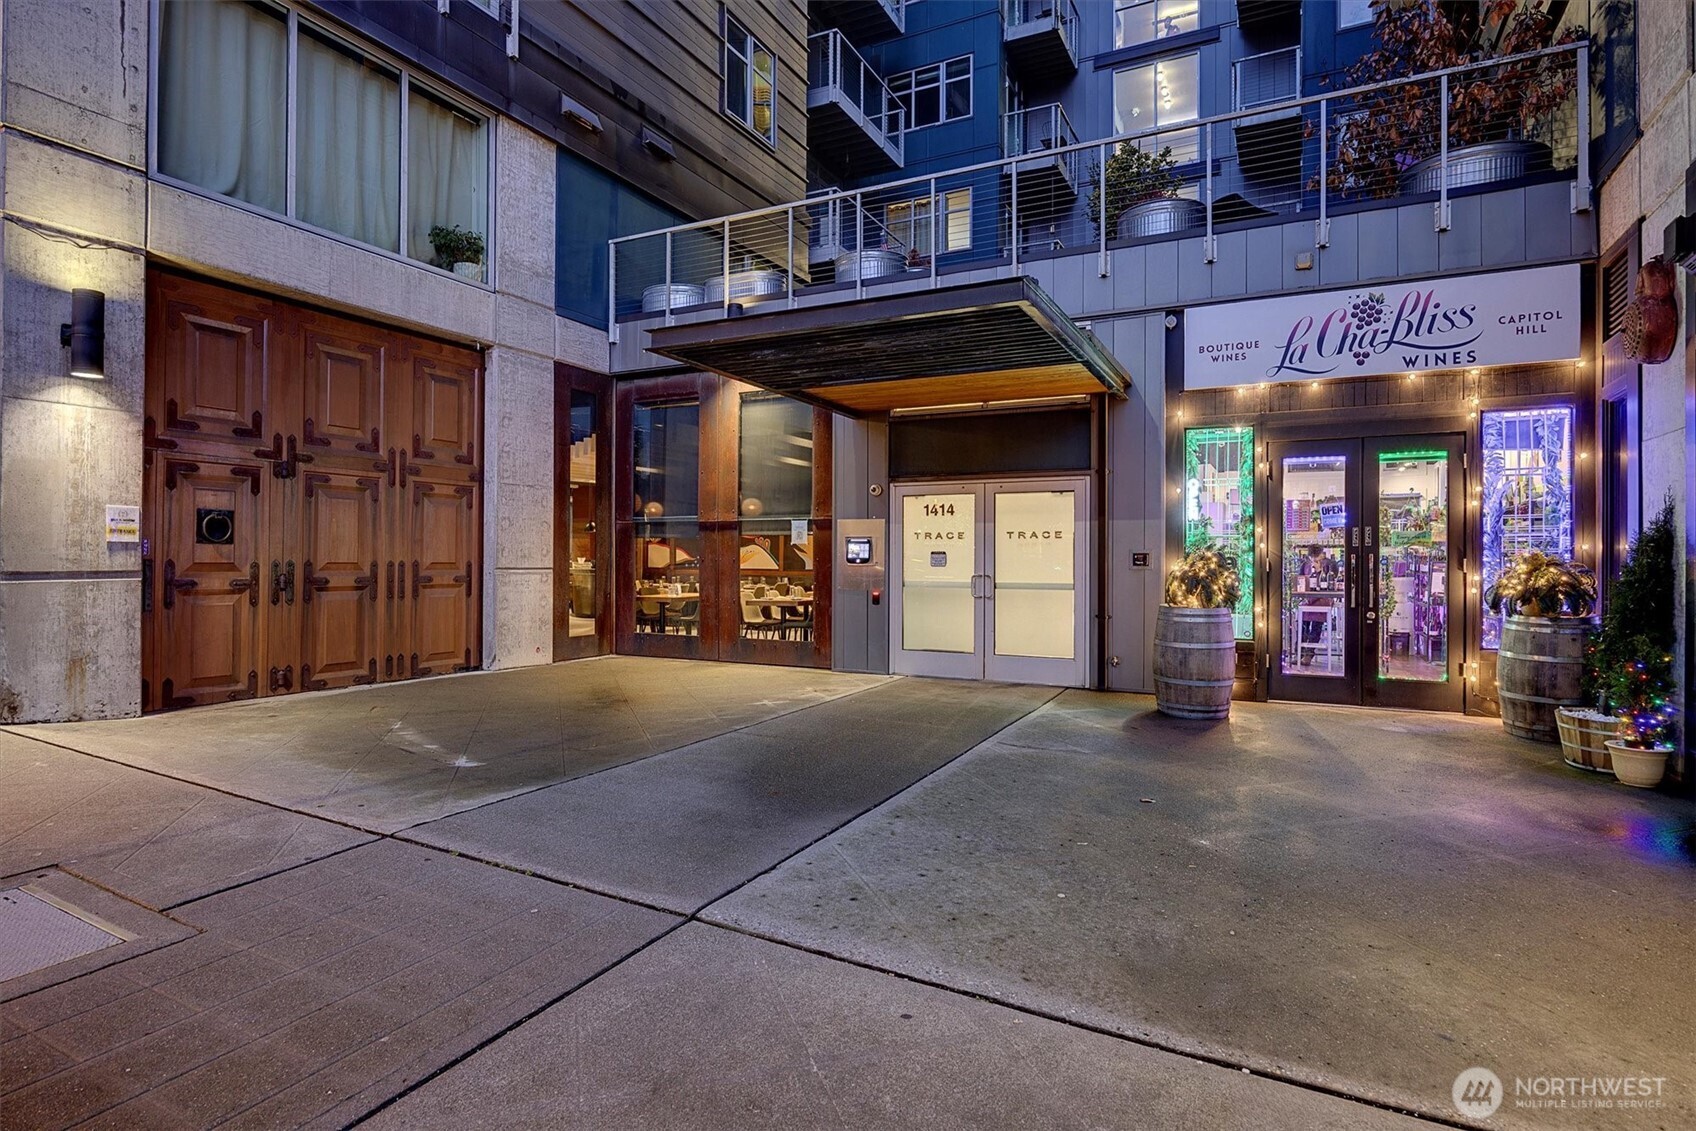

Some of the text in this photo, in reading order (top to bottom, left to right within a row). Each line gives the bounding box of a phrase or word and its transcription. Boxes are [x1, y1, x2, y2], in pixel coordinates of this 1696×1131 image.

[1498, 310, 1563, 325] CAPITOL
[1516, 323, 1548, 335] HILL
[1198, 339, 1261, 354] BOUTIQUE
[1266, 315, 1339, 377] La
[1210, 352, 1248, 363] WINES
[1402, 349, 1478, 369] WINES
[923, 503, 955, 516] 1414
[1321, 504, 1343, 516] OPEN
[914, 531, 965, 539] TRACE
[1006, 530, 1063, 539] TRACE
